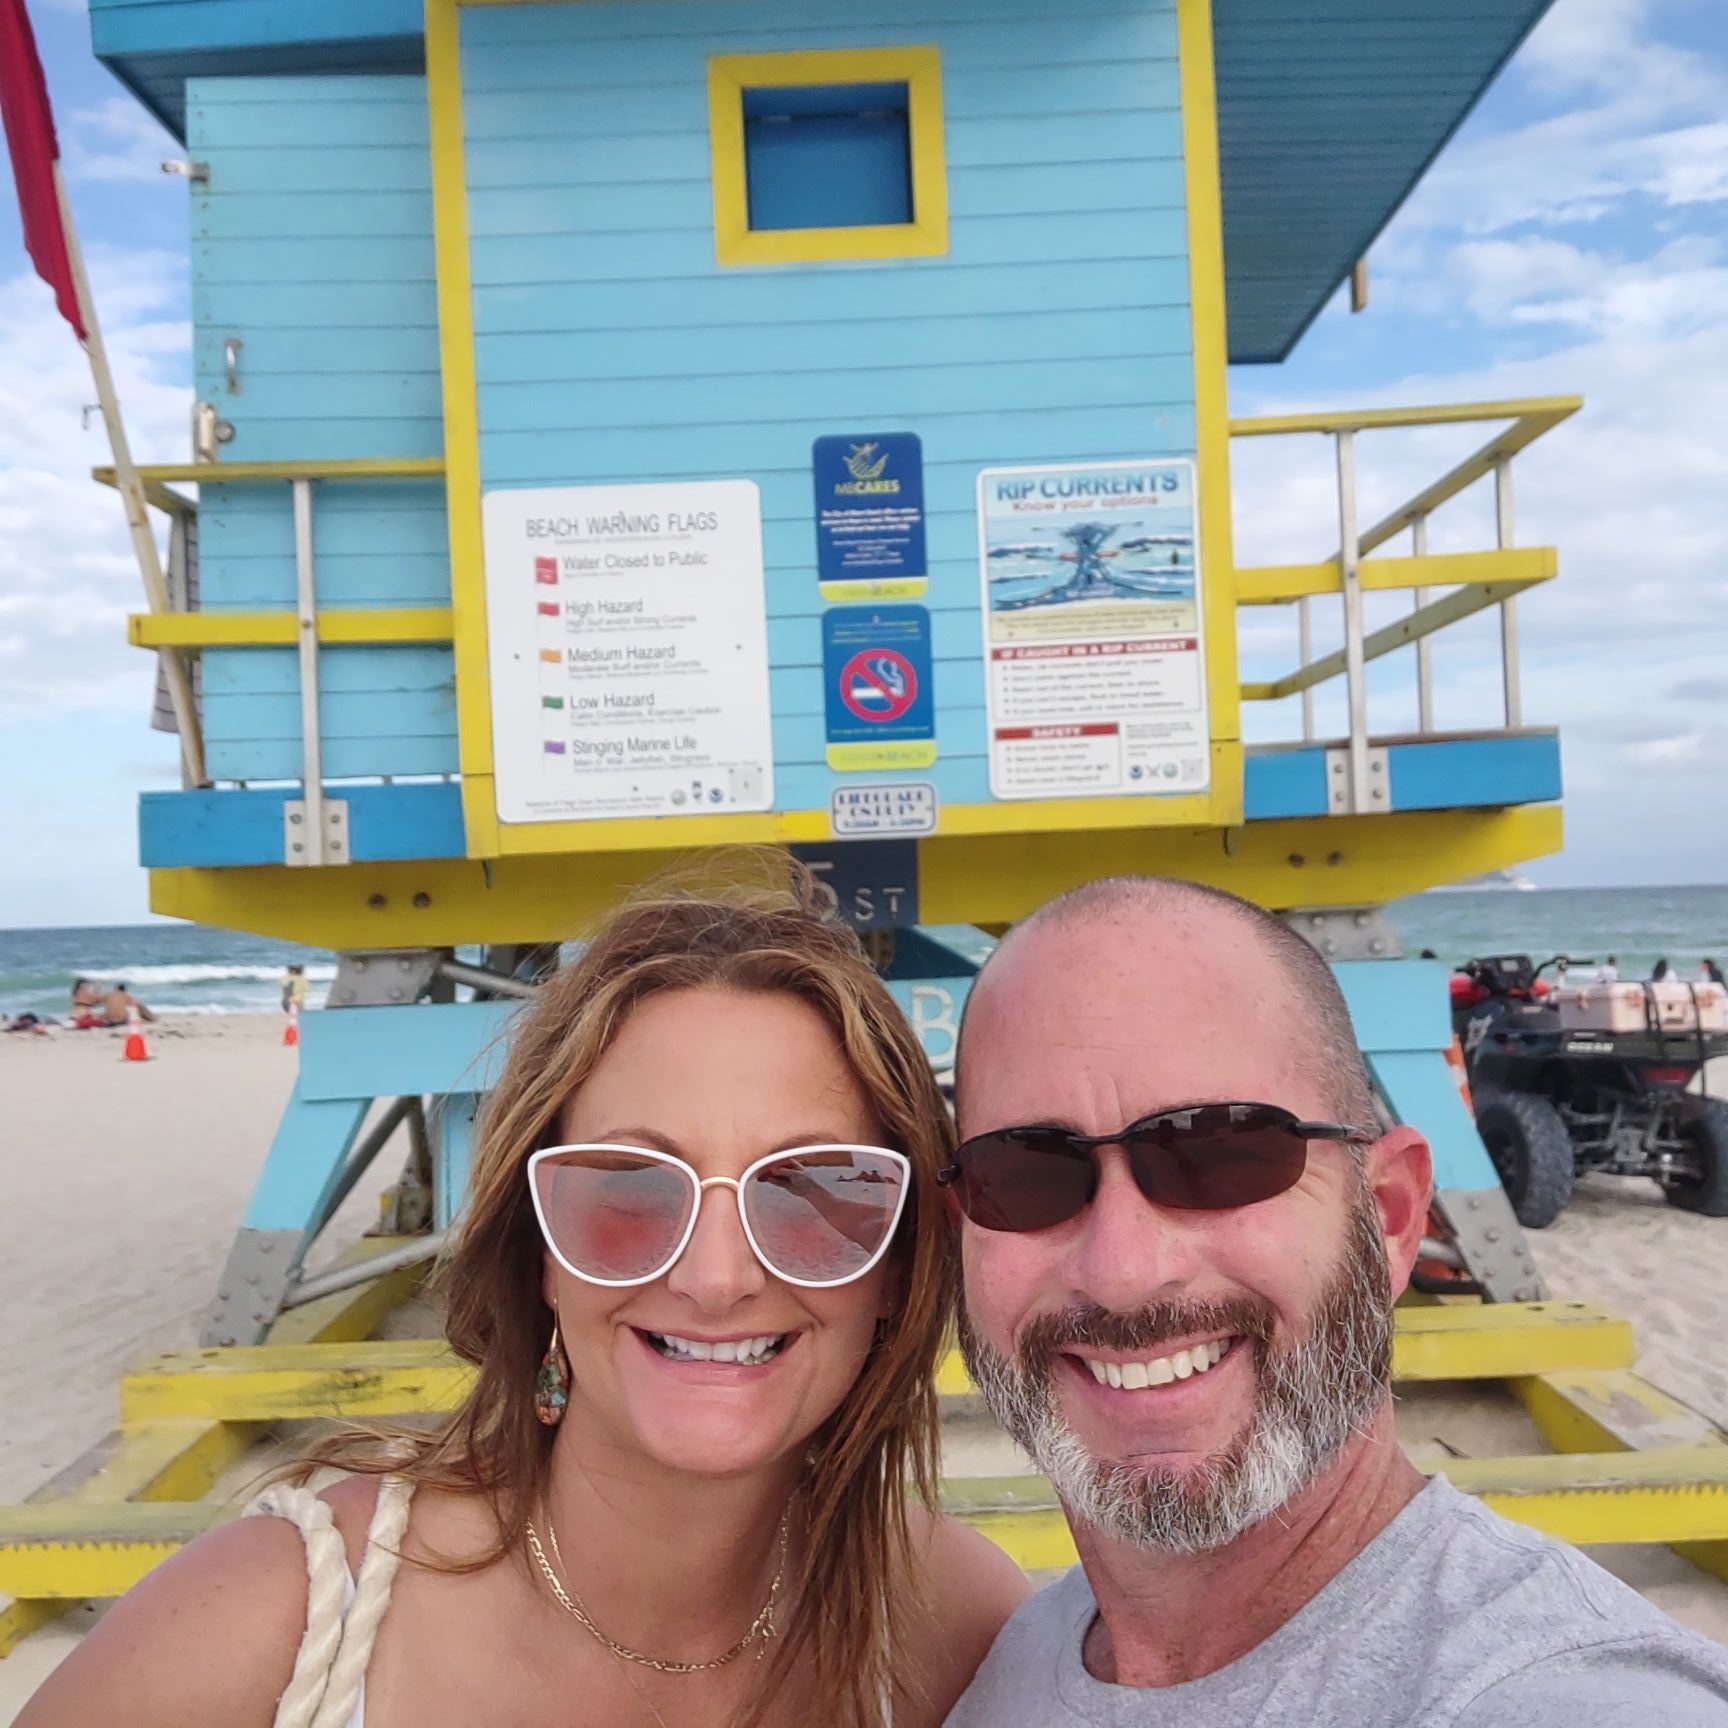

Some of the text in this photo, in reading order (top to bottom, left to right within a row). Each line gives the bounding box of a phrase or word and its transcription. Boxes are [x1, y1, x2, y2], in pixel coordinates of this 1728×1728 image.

[997, 471, 1178, 500] RIP CURRENTS
[526, 511, 718, 538] BEACH WARNING FLAGS
[563, 551, 708, 570] Water Closed to Public
[565, 599, 643, 617] High Hazard
[568, 645, 676, 661] Medium Hazard
[570, 692, 655, 709] Low Hazard
[572, 735, 697, 757] Stinging Marine Life
[855, 886, 906, 920] ST
